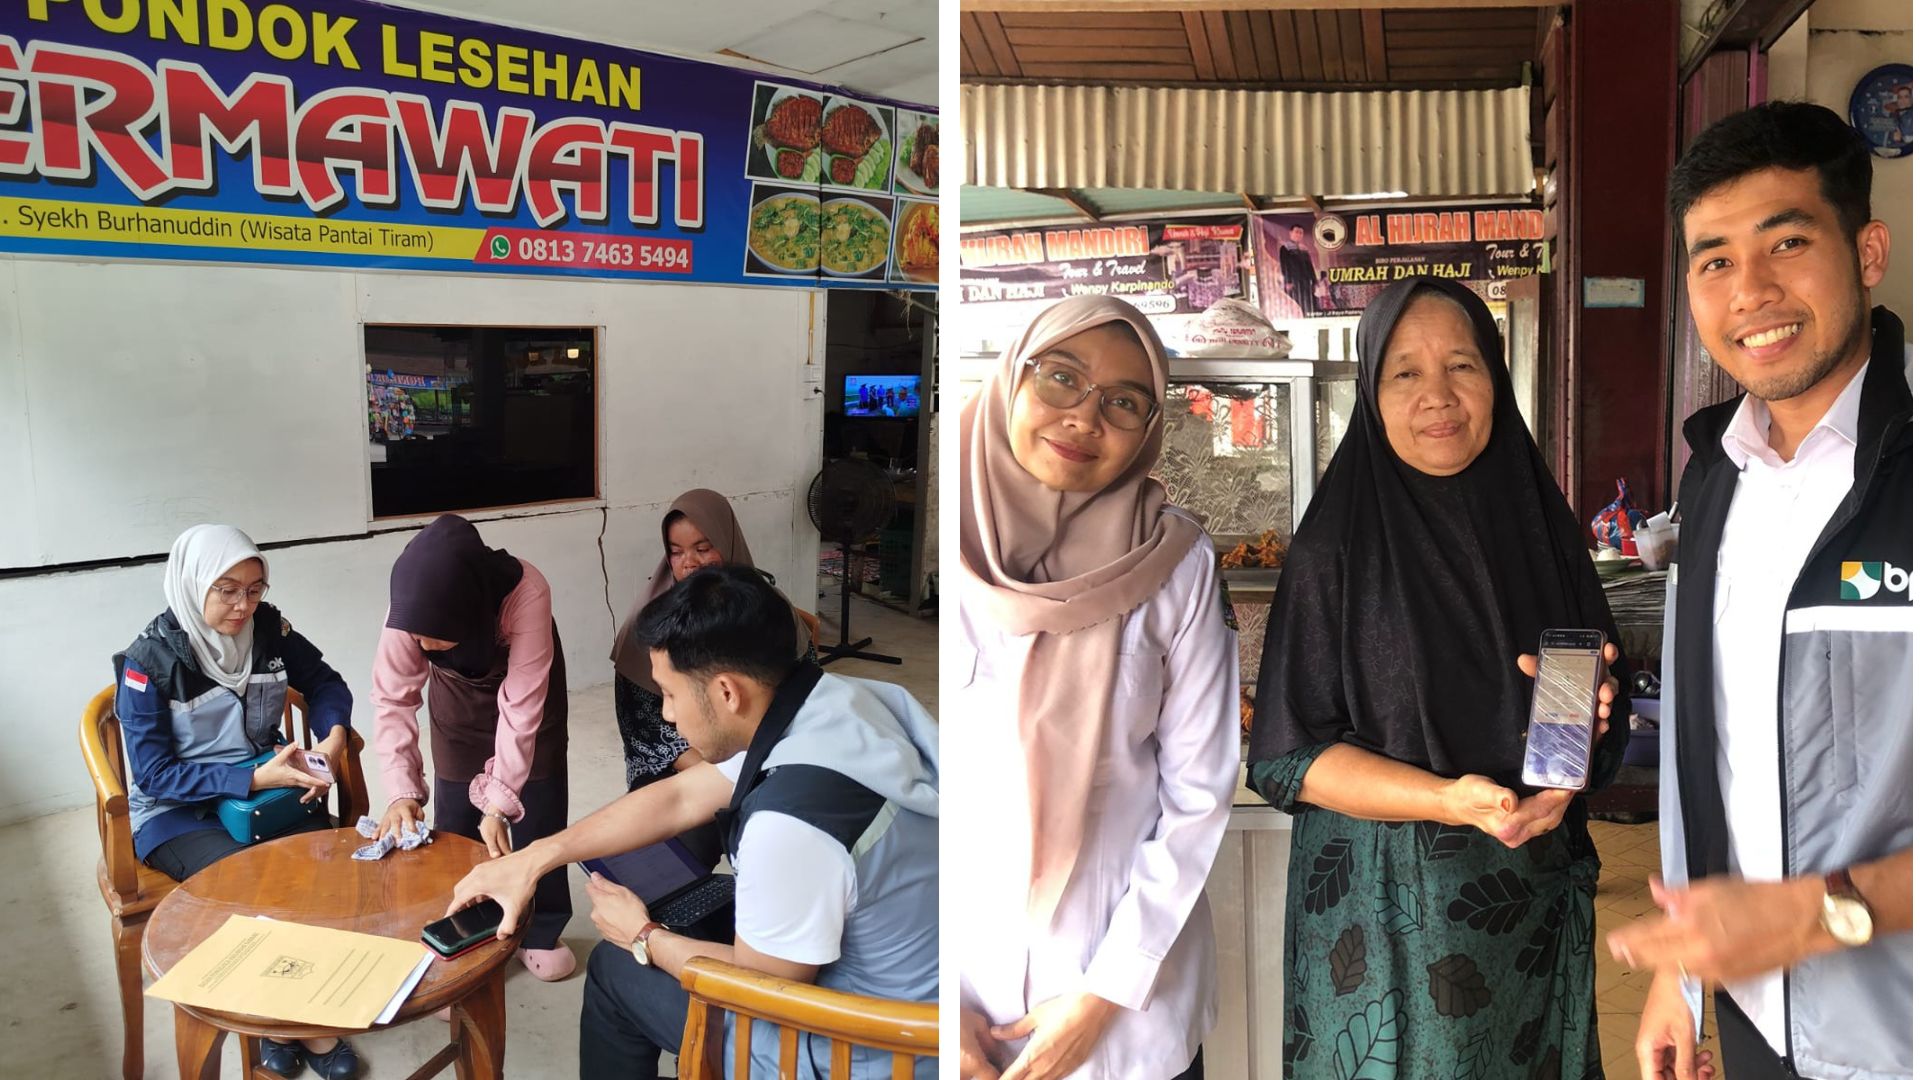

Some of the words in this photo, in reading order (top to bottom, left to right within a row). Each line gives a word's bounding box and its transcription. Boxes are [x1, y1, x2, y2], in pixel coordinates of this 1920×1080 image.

[383, 24, 642, 111] LESEHAN
[18, 205, 89, 232] Syekh
[97, 210, 232, 237] Burhanuddin
[240, 219, 312, 243] (Wisata
[319, 225, 373, 245] Pantai
[378, 228, 434, 253] Tiram)
[1045, 225, 1150, 262] MANDIRI
[1356, 215, 1385, 246] AL
[1386, 212, 1472, 245] HIJRAH
[518, 237, 575, 263] 0813
[582, 242, 634, 266] 7463
[640, 246, 689, 269] 5494
[1485, 243, 1515, 260] Tour
[1519, 242, 1530, 258] &
[1092, 260, 1104, 277] &
[1329, 266, 1389, 282] UMRAH
[1393, 264, 1429, 280] DAN
[1432, 262, 1473, 278] HAJI
